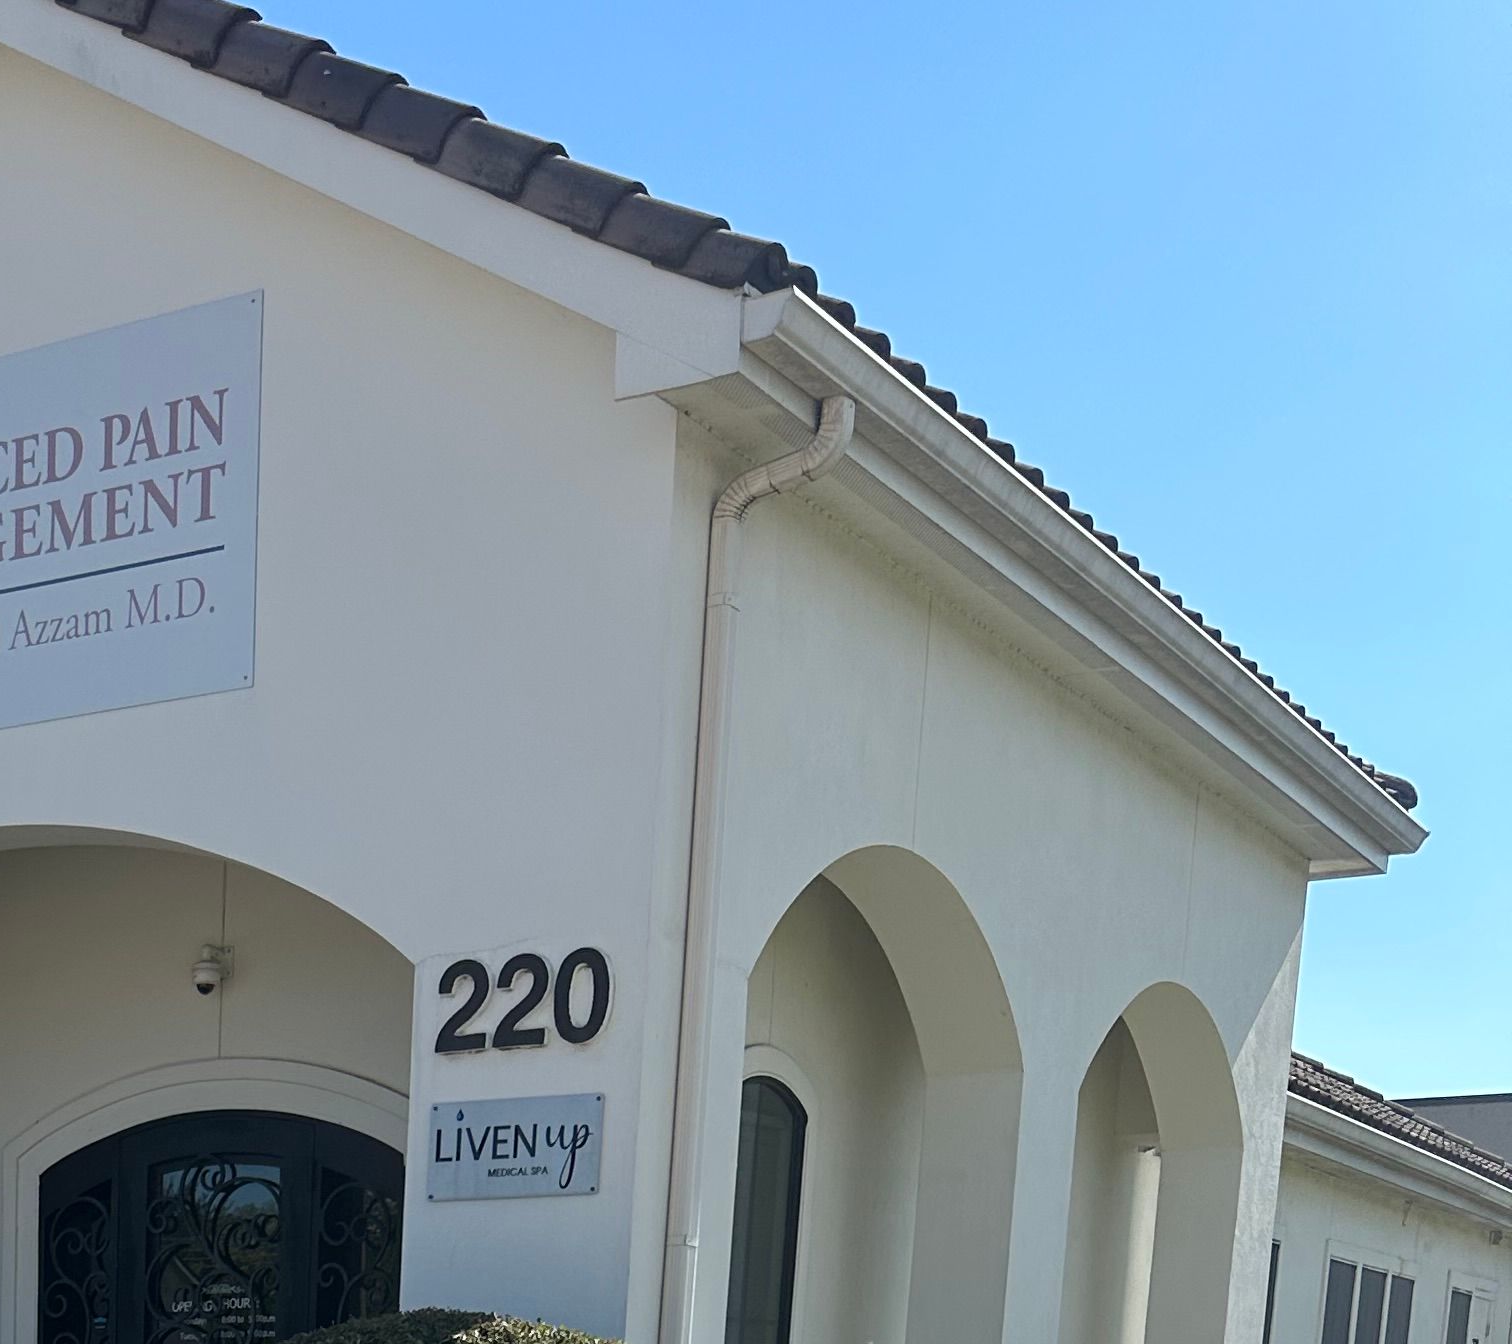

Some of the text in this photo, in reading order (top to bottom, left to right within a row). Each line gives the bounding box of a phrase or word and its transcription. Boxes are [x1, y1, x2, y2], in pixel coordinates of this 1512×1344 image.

[99, 388, 229, 472] PAIN
[8, 608, 113, 650] Azzam
[125, 576, 216, 629] M.D.
[435, 947, 610, 1054] 220
[488, 1166, 548, 1178] MEDICAL SPA
[545, 1122, 594, 1189] up
